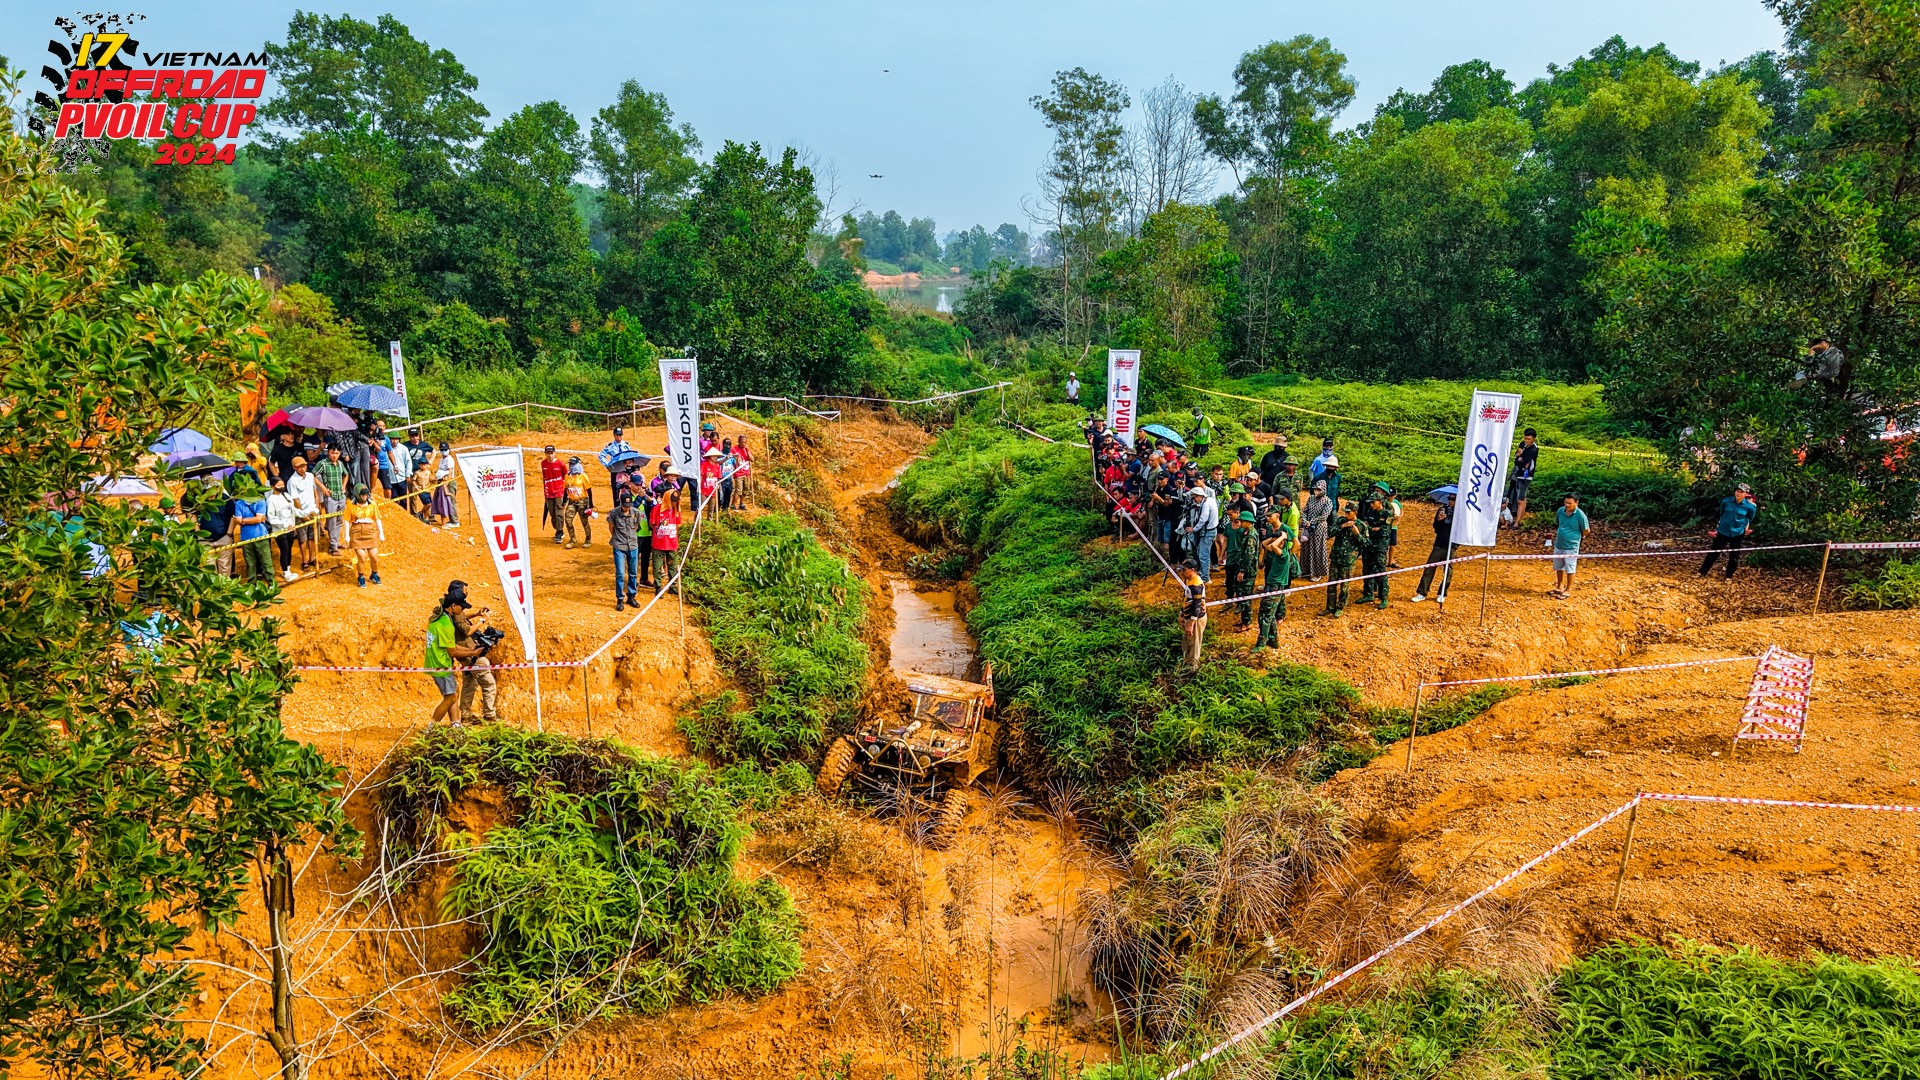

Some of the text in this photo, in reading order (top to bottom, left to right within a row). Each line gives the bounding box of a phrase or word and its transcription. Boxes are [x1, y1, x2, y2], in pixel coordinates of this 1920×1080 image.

[677, 393, 692, 464] SKODA
[501, 479, 517, 487] CUP
[1465, 443, 1499, 513] Ford
